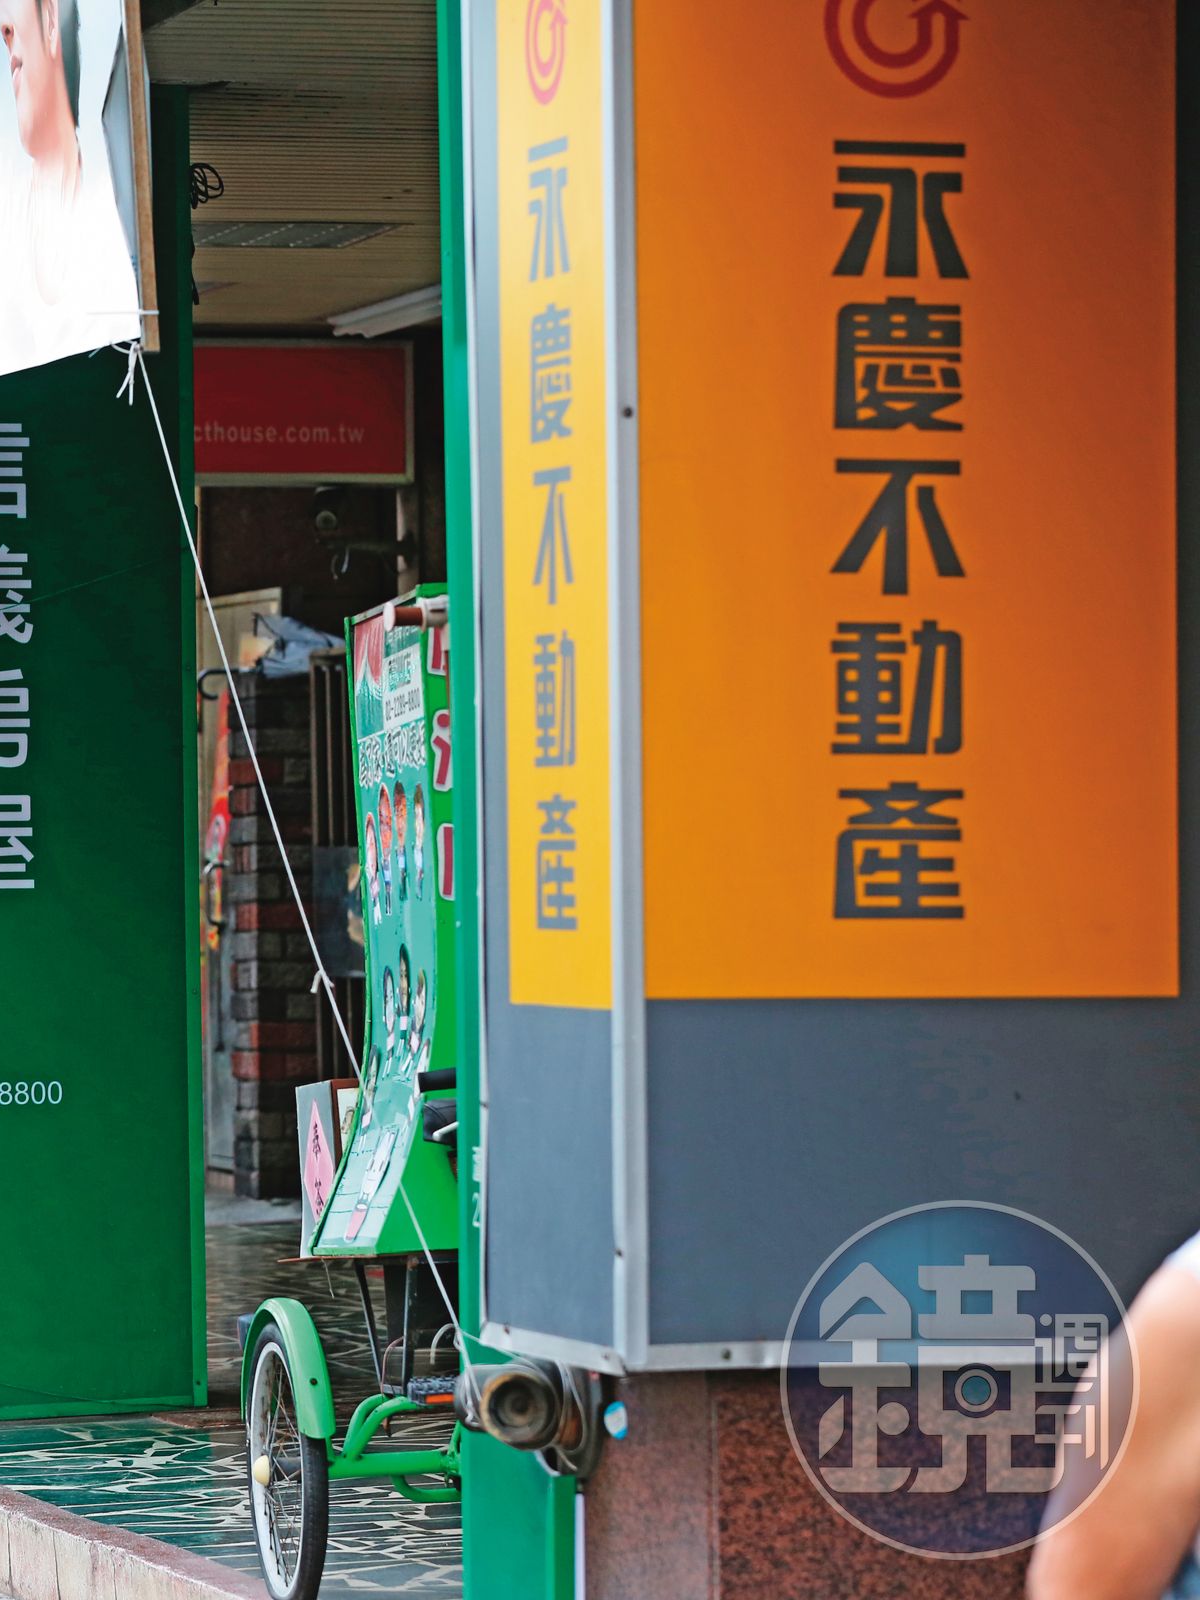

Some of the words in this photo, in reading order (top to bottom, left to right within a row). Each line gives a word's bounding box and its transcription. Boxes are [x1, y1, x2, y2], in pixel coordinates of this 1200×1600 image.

[528, 136, 577, 930] 永慶不動產
[830, 139, 970, 919] 永慶不動產
